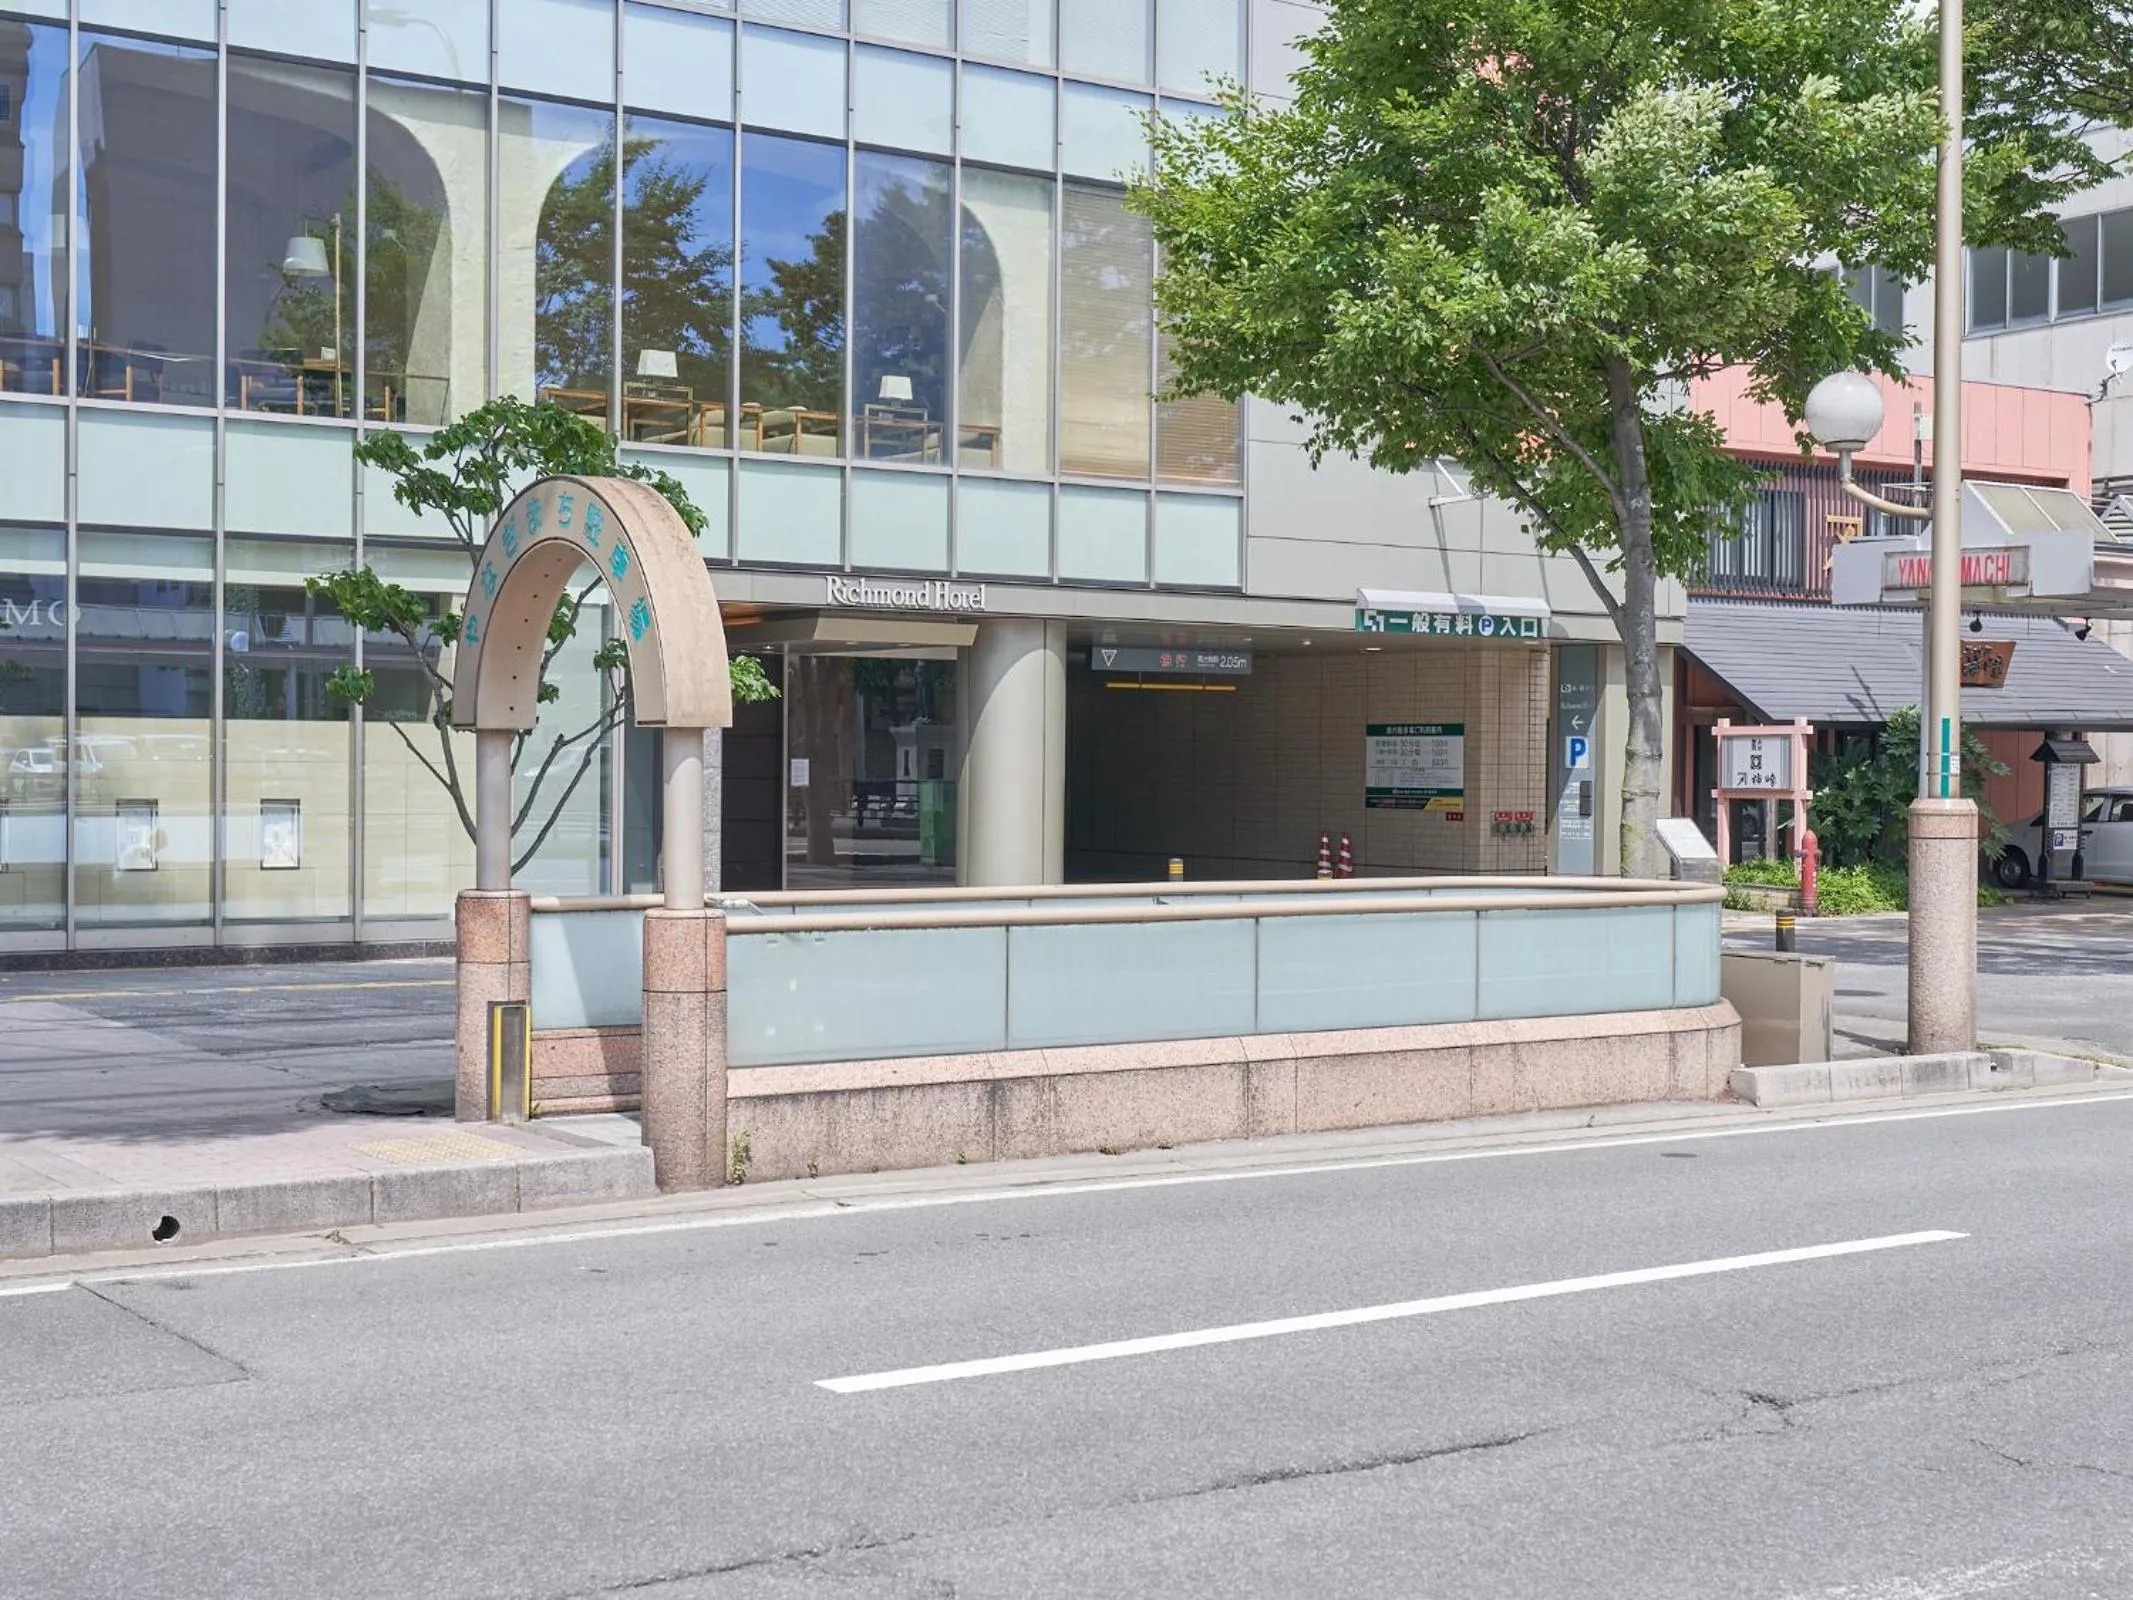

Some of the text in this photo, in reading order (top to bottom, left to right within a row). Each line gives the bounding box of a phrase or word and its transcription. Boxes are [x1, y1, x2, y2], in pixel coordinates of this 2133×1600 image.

[826, 575, 986, 610] Richmond Hotel
[1569, 737, 1587, 768] P
